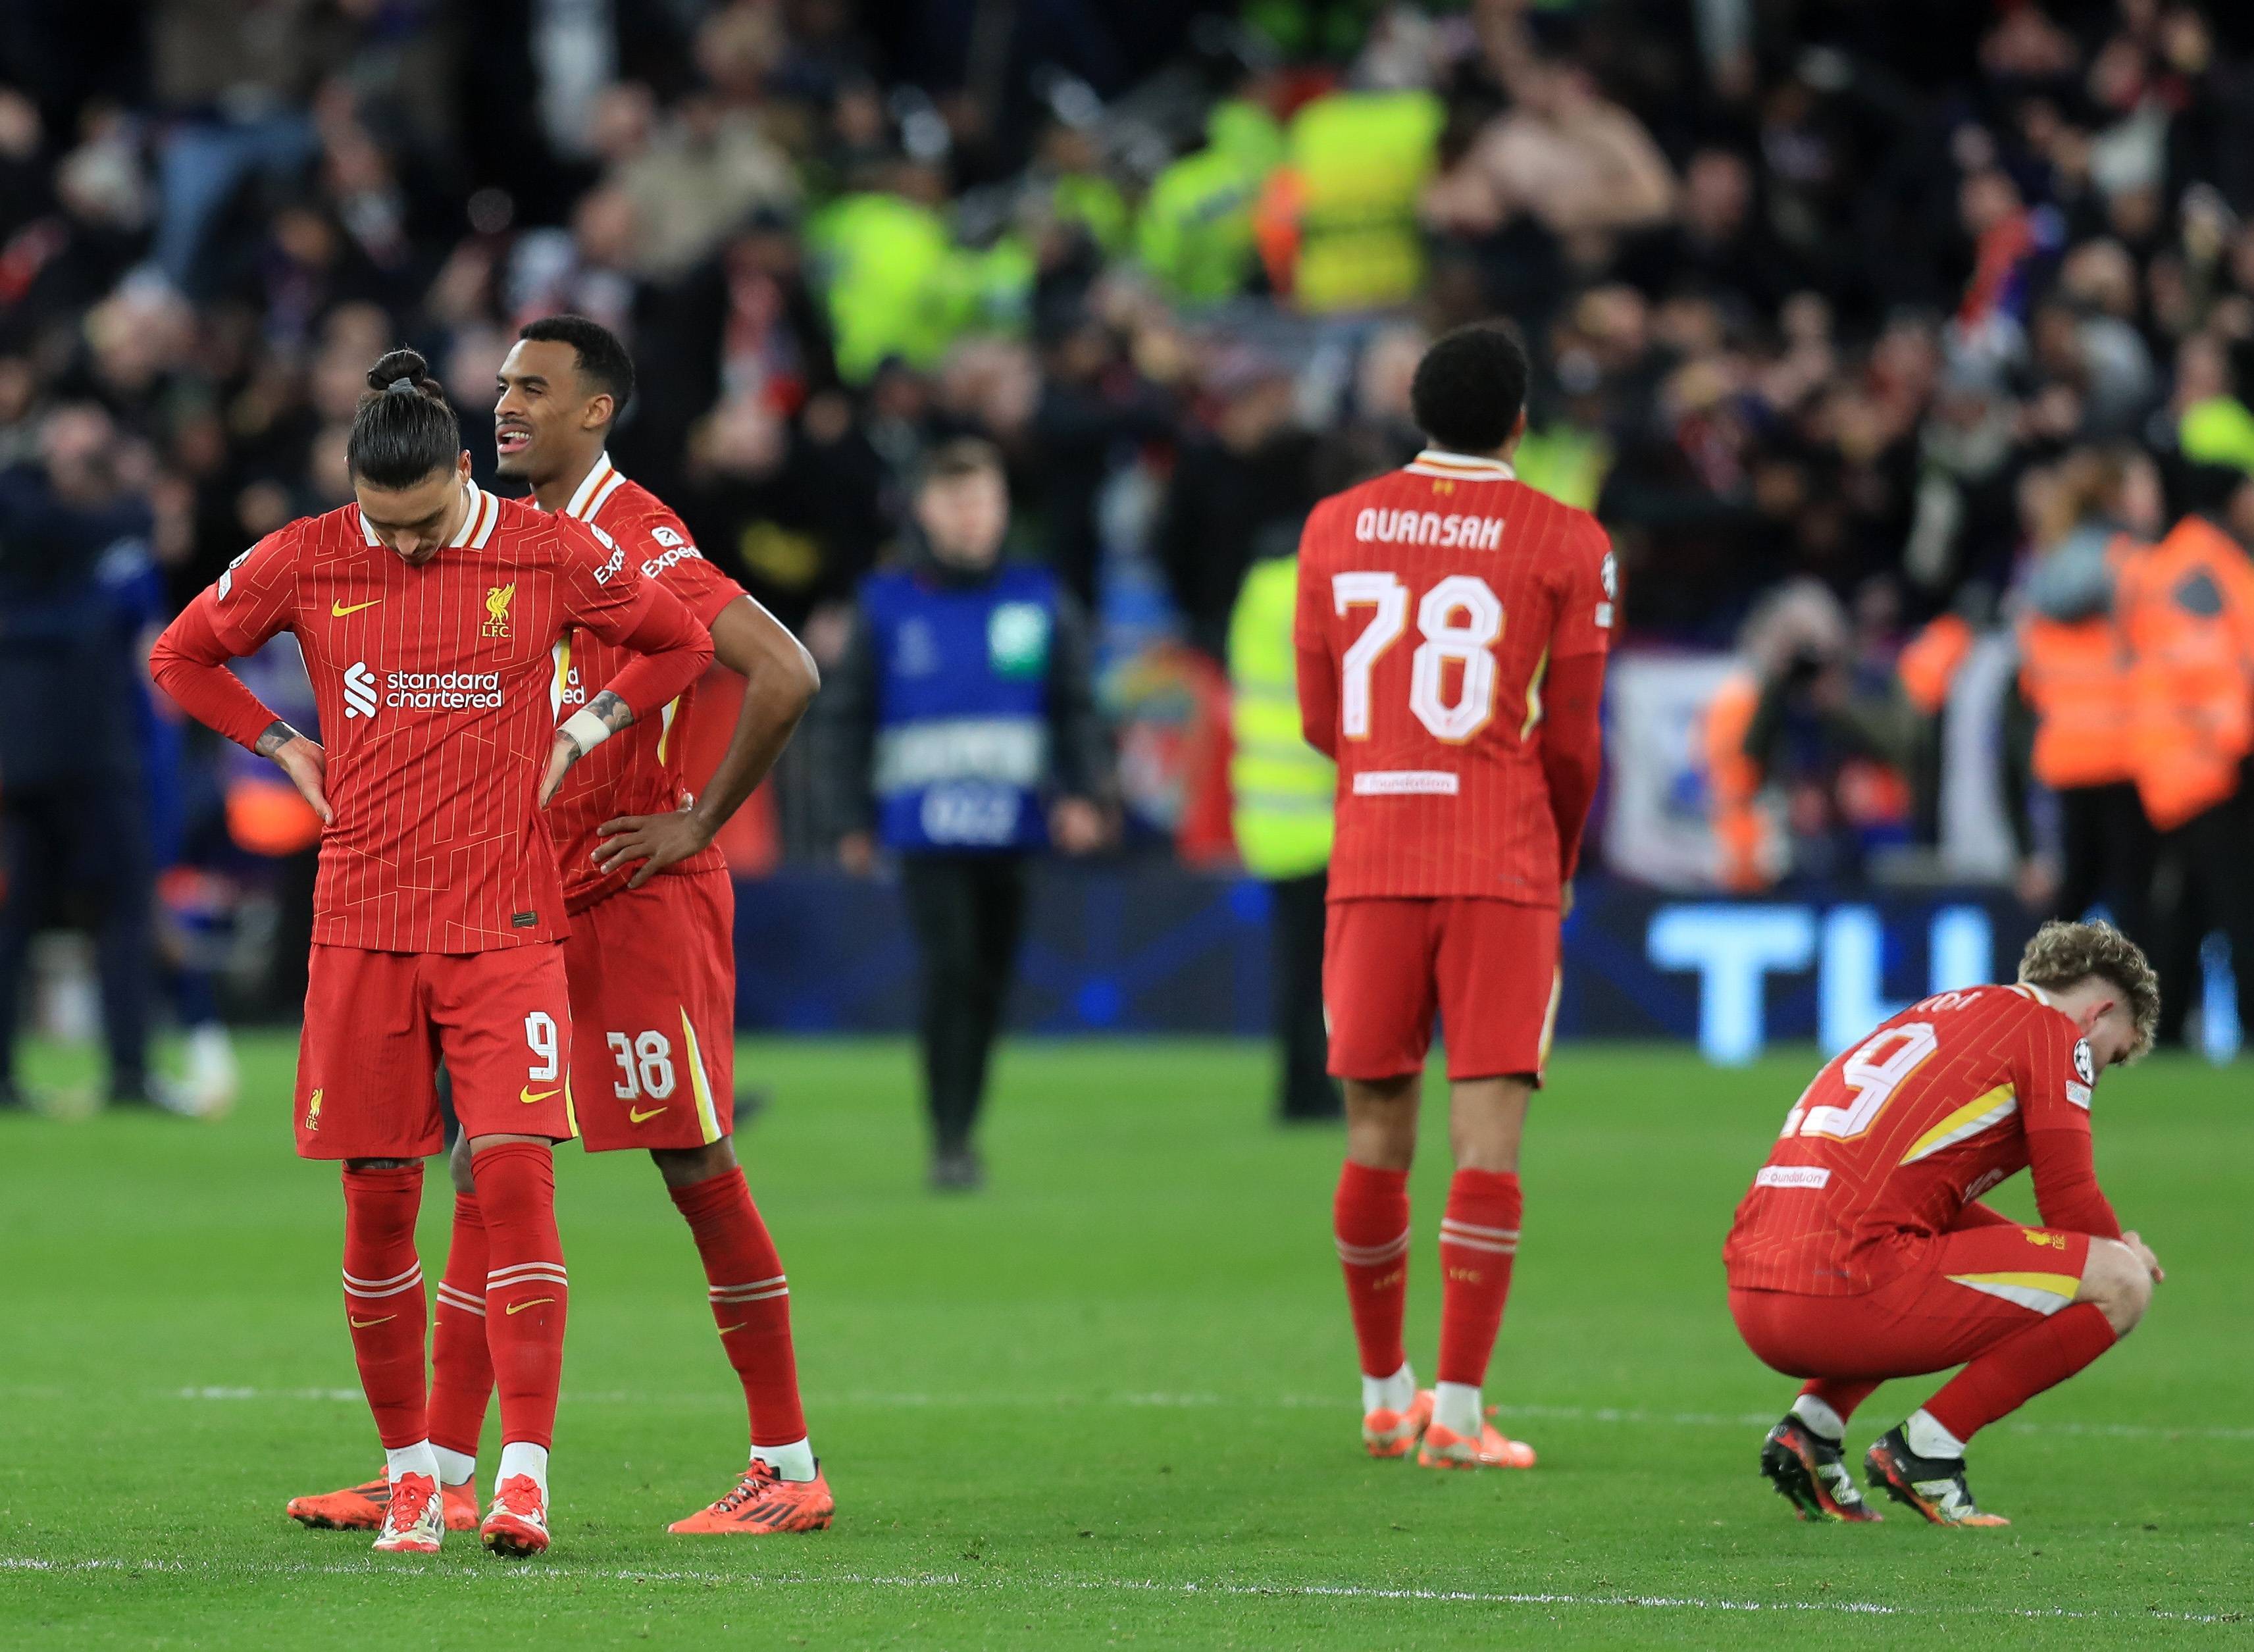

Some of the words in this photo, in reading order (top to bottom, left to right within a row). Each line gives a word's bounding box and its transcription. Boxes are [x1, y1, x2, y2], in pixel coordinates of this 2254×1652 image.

[1354, 507, 1504, 551] QUANSAH
[386, 669, 499, 690] standard
[1331, 570, 1507, 746] 78
[385, 689, 502, 708] chartered
[525, 1011, 558, 1082] 9
[606, 1029, 676, 1100] 38
